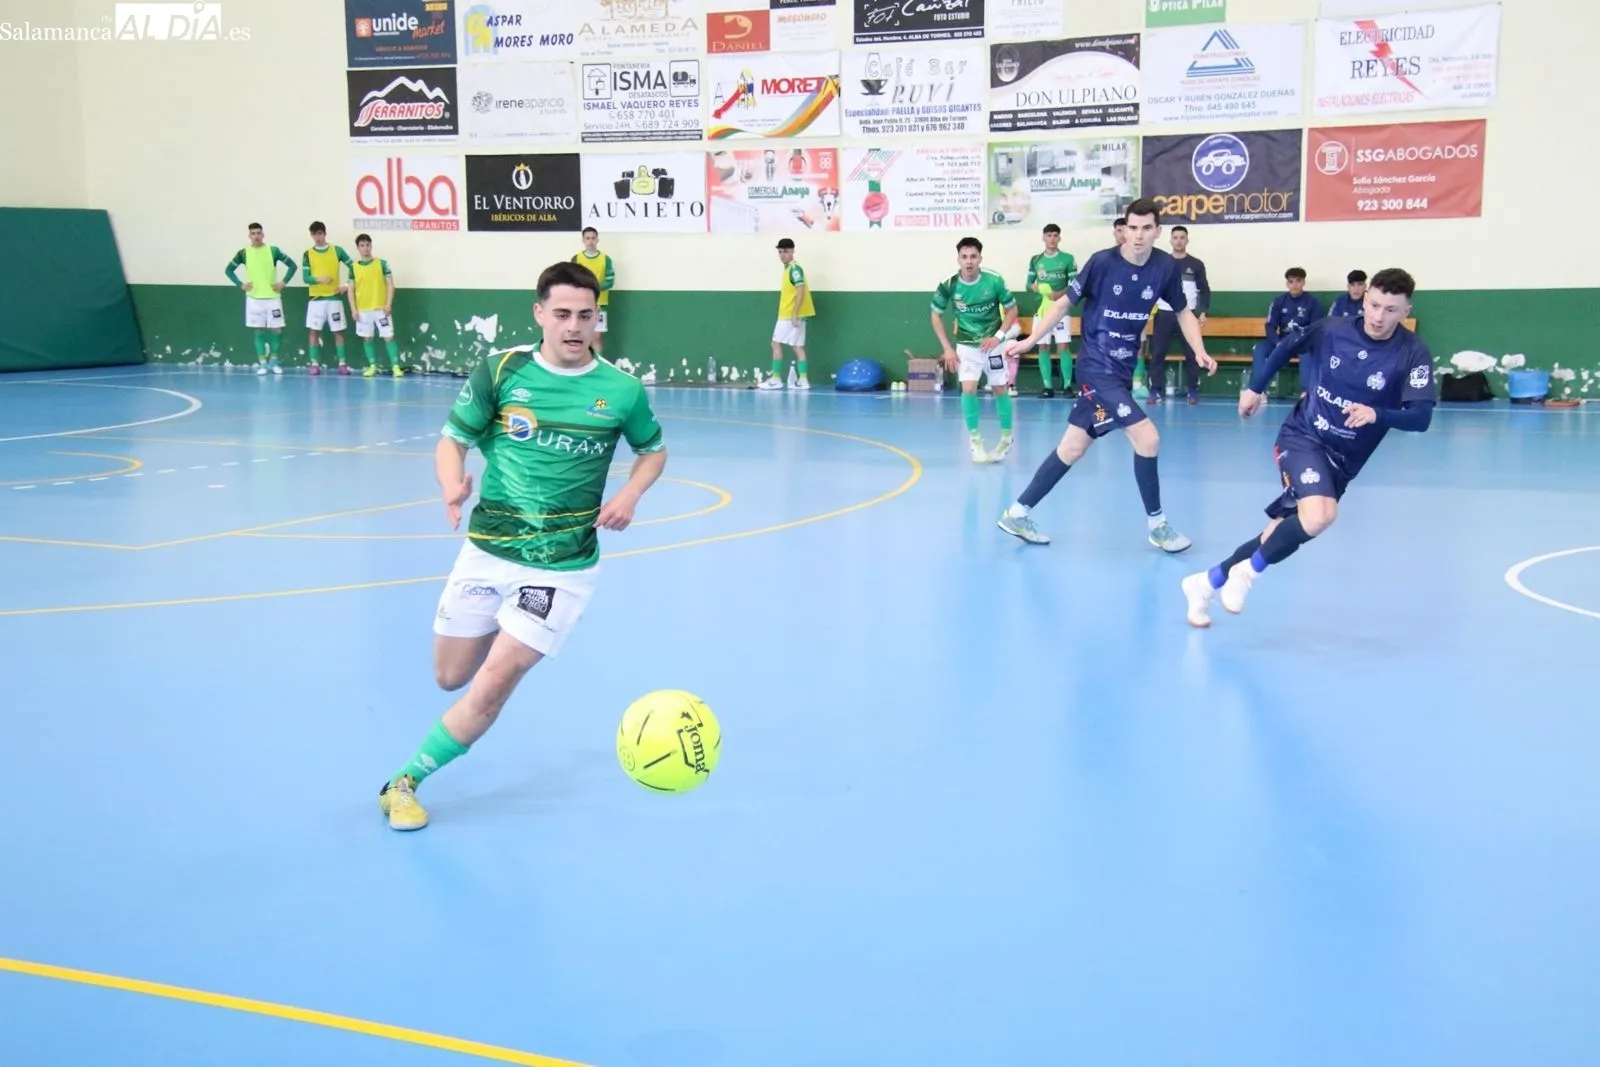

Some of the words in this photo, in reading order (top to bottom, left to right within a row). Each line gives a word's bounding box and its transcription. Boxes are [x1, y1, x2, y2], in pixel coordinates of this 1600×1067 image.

[372, 12, 418, 32] unide
[933, 13, 946, 21] FOTO
[948, 12, 970, 20] ESTUDIO
[412, 20, 445, 39] market
[578, 17, 699, 36] ALAMEDA
[539, 33, 574, 46] MORO
[1339, 24, 1435, 46] ELECTRICIDAD
[712, 40, 765, 52] DANIEL
[928, 58, 968, 76] Bar
[1350, 56, 1422, 80] REYES
[613, 70, 668, 92] ISMA
[1016, 90, 1052, 108] DON
[1059, 84, 1137, 104] ULPIANO
[583, 102, 617, 110] ISMAEL
[620, 100, 666, 110] VAQUERO
[669, 99, 700, 108] REYES
[892, 106, 915, 116] PAELLA
[948, 104, 982, 112] GIGANTES
[1207, 103, 1222, 112] 645
[354, 99, 445, 127] SERRANITOS
[616, 111, 634, 120] 658
[638, 110, 656, 120] 770
[659, 110, 676, 118] 401
[583, 122, 614, 130] Servicio
[642, 120, 660, 129] 689
[663, 120, 679, 128] 724
[682, 119, 700, 128] 909
[882, 124, 894, 133] 923
[939, 123, 951, 131] 962
[1102, 143, 1128, 151] MILAR
[1030, 178, 1066, 188] COMERCIAL
[1069, 177, 1102, 190] Anaya
[1373, 175, 1406, 184] Sánchez
[1408, 174, 1436, 183] García
[356, 157, 458, 216] alba
[748, 186, 779, 196] COMERCIAL
[781, 186, 810, 199] Anaya
[1352, 186, 1391, 195] Abogada
[474, 194, 490, 210] EL
[493, 194, 575, 210] VENTORRO
[1152, 188, 1294, 220] carpemotor
[1357, 200, 1378, 211] 923
[1381, 199, 1403, 210] 300
[1406, 198, 1428, 210] 844
[588, 201, 704, 218] AUNIETO
[1224, 212, 1294, 220] www.carpemotor.com
[491, 213, 526, 222] IBÉRICOS
[526, 214, 537, 222] DE
[539, 213, 558, 222] ALBA
[413, 220, 458, 230] GRANITOS
[1103, 309, 1153, 321] EXLABESA
